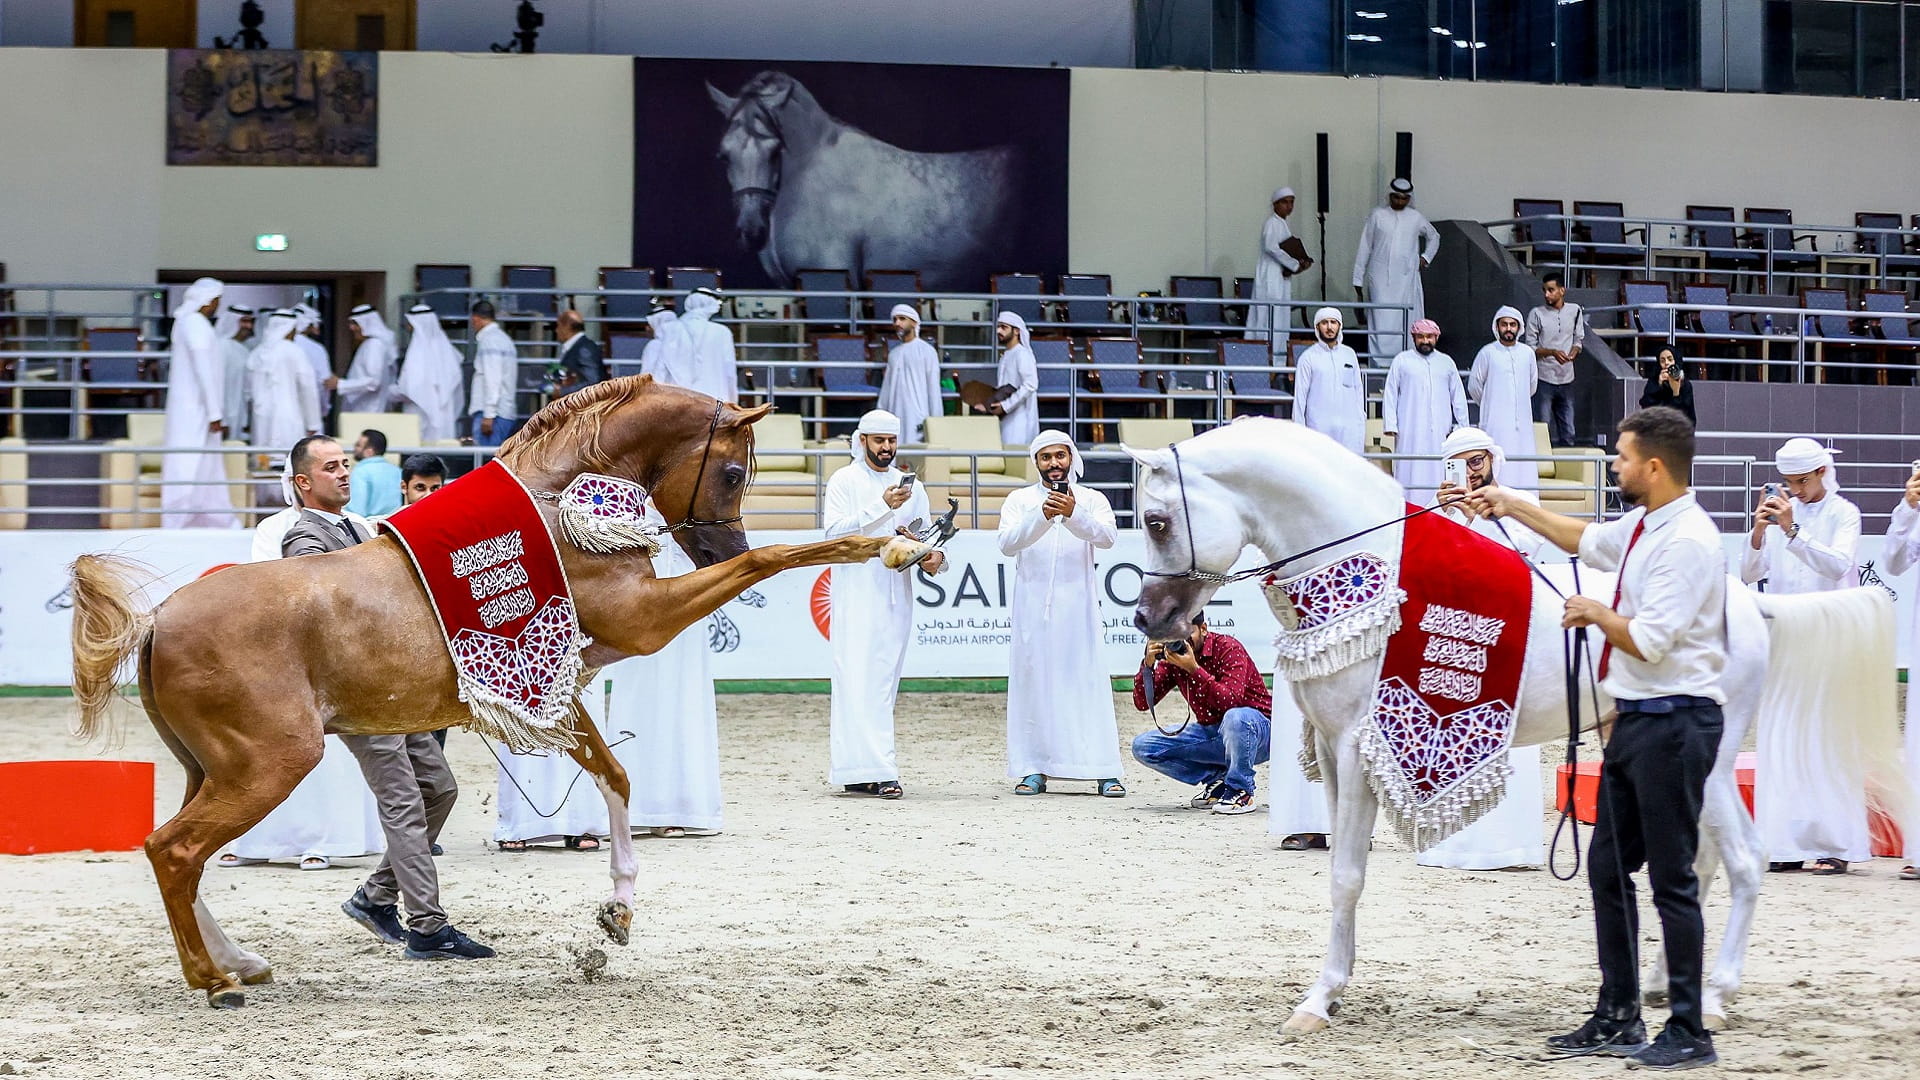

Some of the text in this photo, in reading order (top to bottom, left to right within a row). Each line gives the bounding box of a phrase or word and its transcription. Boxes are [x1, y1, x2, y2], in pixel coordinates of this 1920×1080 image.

[916, 562, 1008, 608] SAI
[917, 618, 964, 634] الدولي
[917, 634, 969, 646] SHARJAH
[971, 634, 1012, 645] AIRPOR
[1112, 633, 1138, 644] FREE
